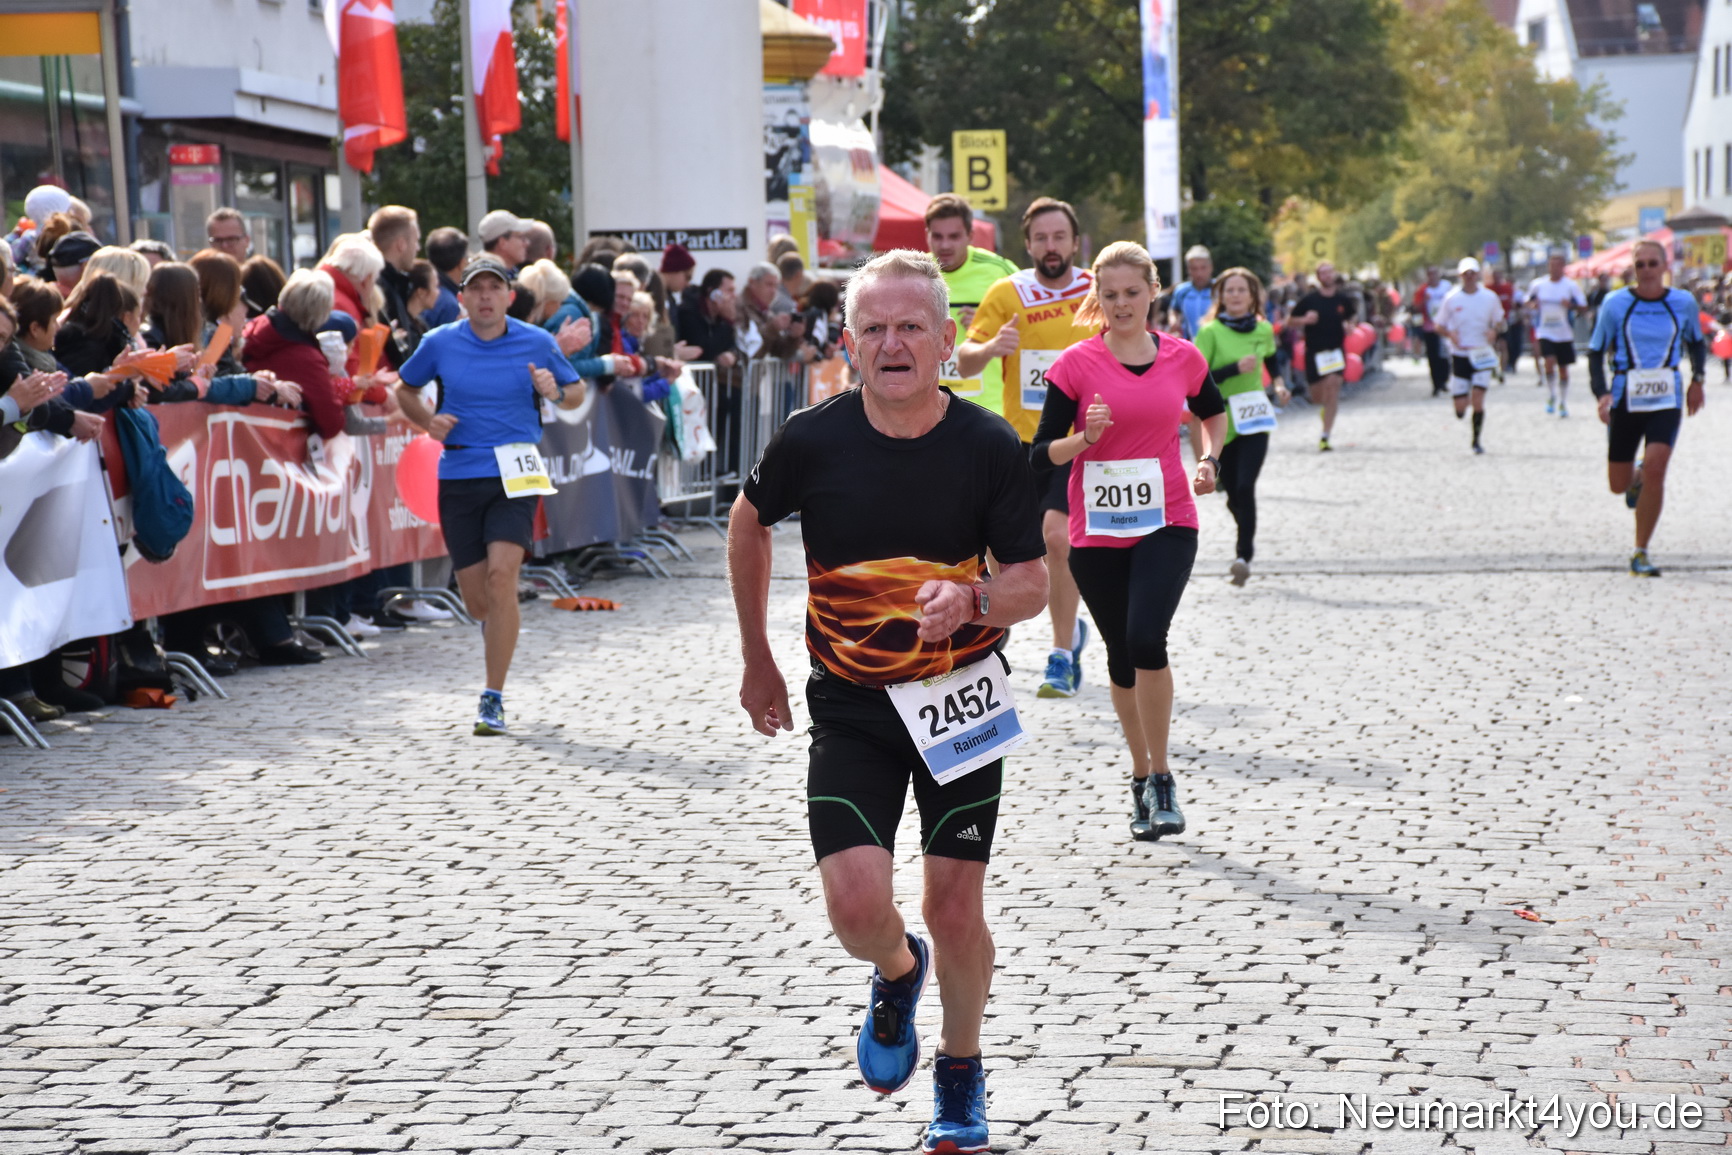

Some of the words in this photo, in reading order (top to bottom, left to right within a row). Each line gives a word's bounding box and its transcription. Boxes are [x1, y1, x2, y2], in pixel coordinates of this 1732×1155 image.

[968, 155, 992, 191] B
[1311, 236, 1328, 258] C
[1026, 306, 1066, 325] MAX
[1635, 381, 1669, 395] 2700
[1094, 482, 1152, 508] 2019
[1110, 515, 1138, 525] Andrea
[918, 676, 1002, 739] 2452
[952, 724, 999, 755] Raimund
[956, 832, 982, 842] adidas
